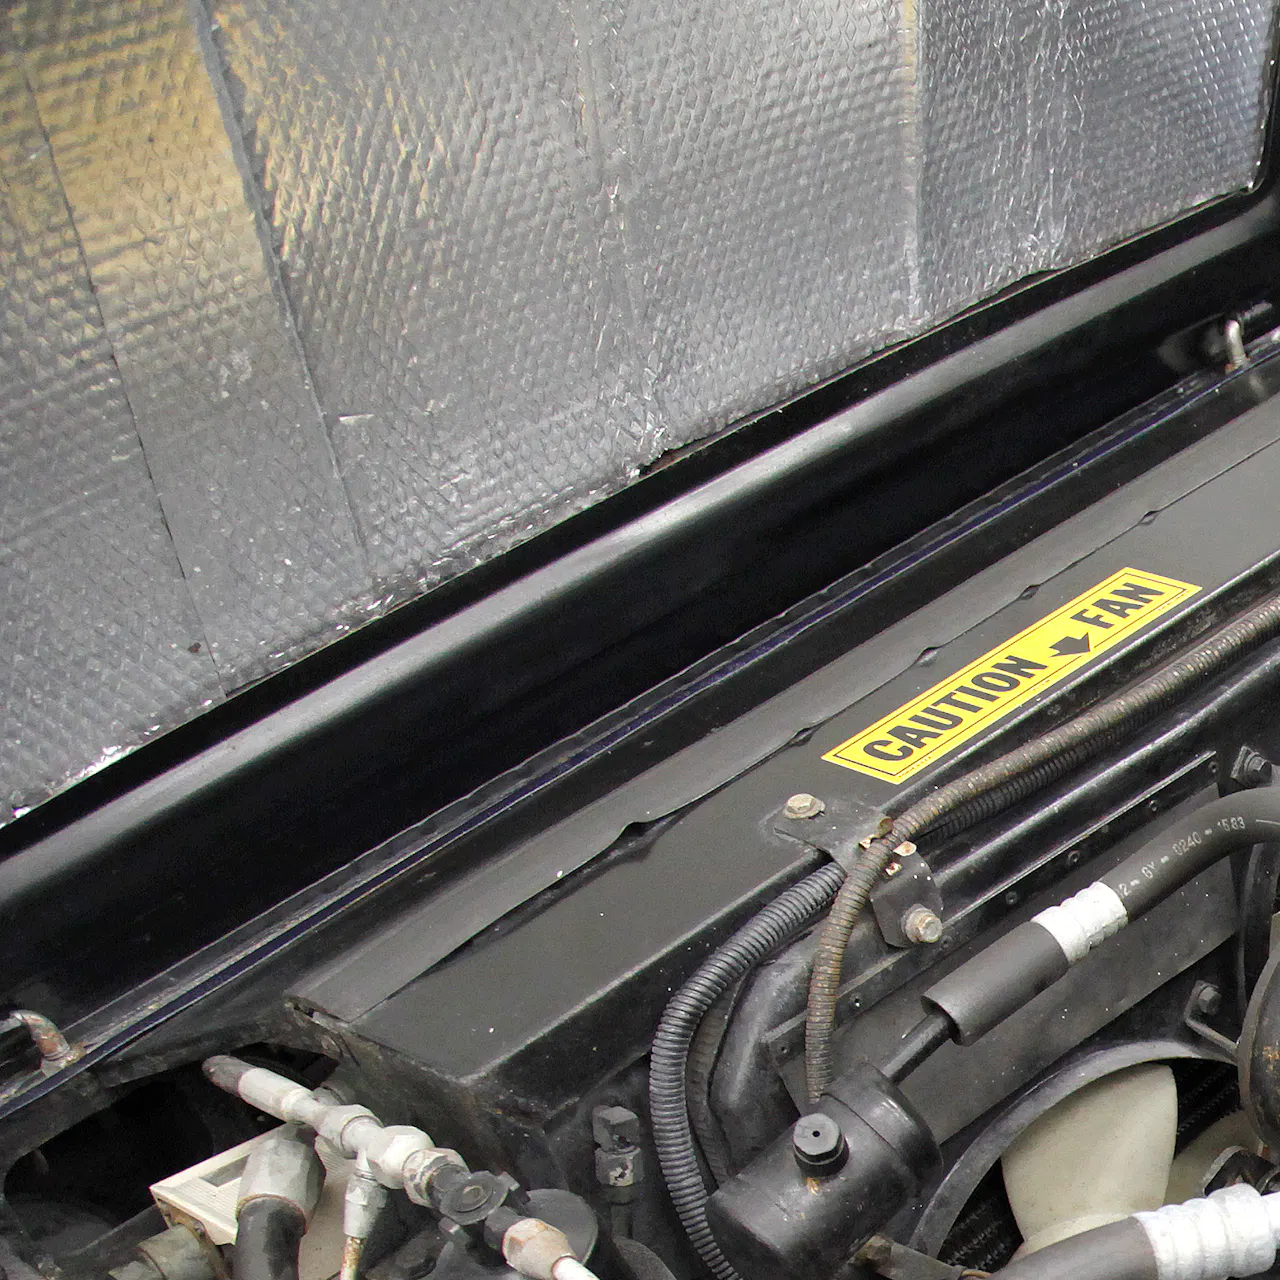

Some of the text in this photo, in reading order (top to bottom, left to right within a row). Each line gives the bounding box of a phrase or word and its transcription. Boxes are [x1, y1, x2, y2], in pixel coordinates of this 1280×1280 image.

[862, 581, 1165, 761] CAUTION FAN
[1172, 831, 1203, 856] 0240
